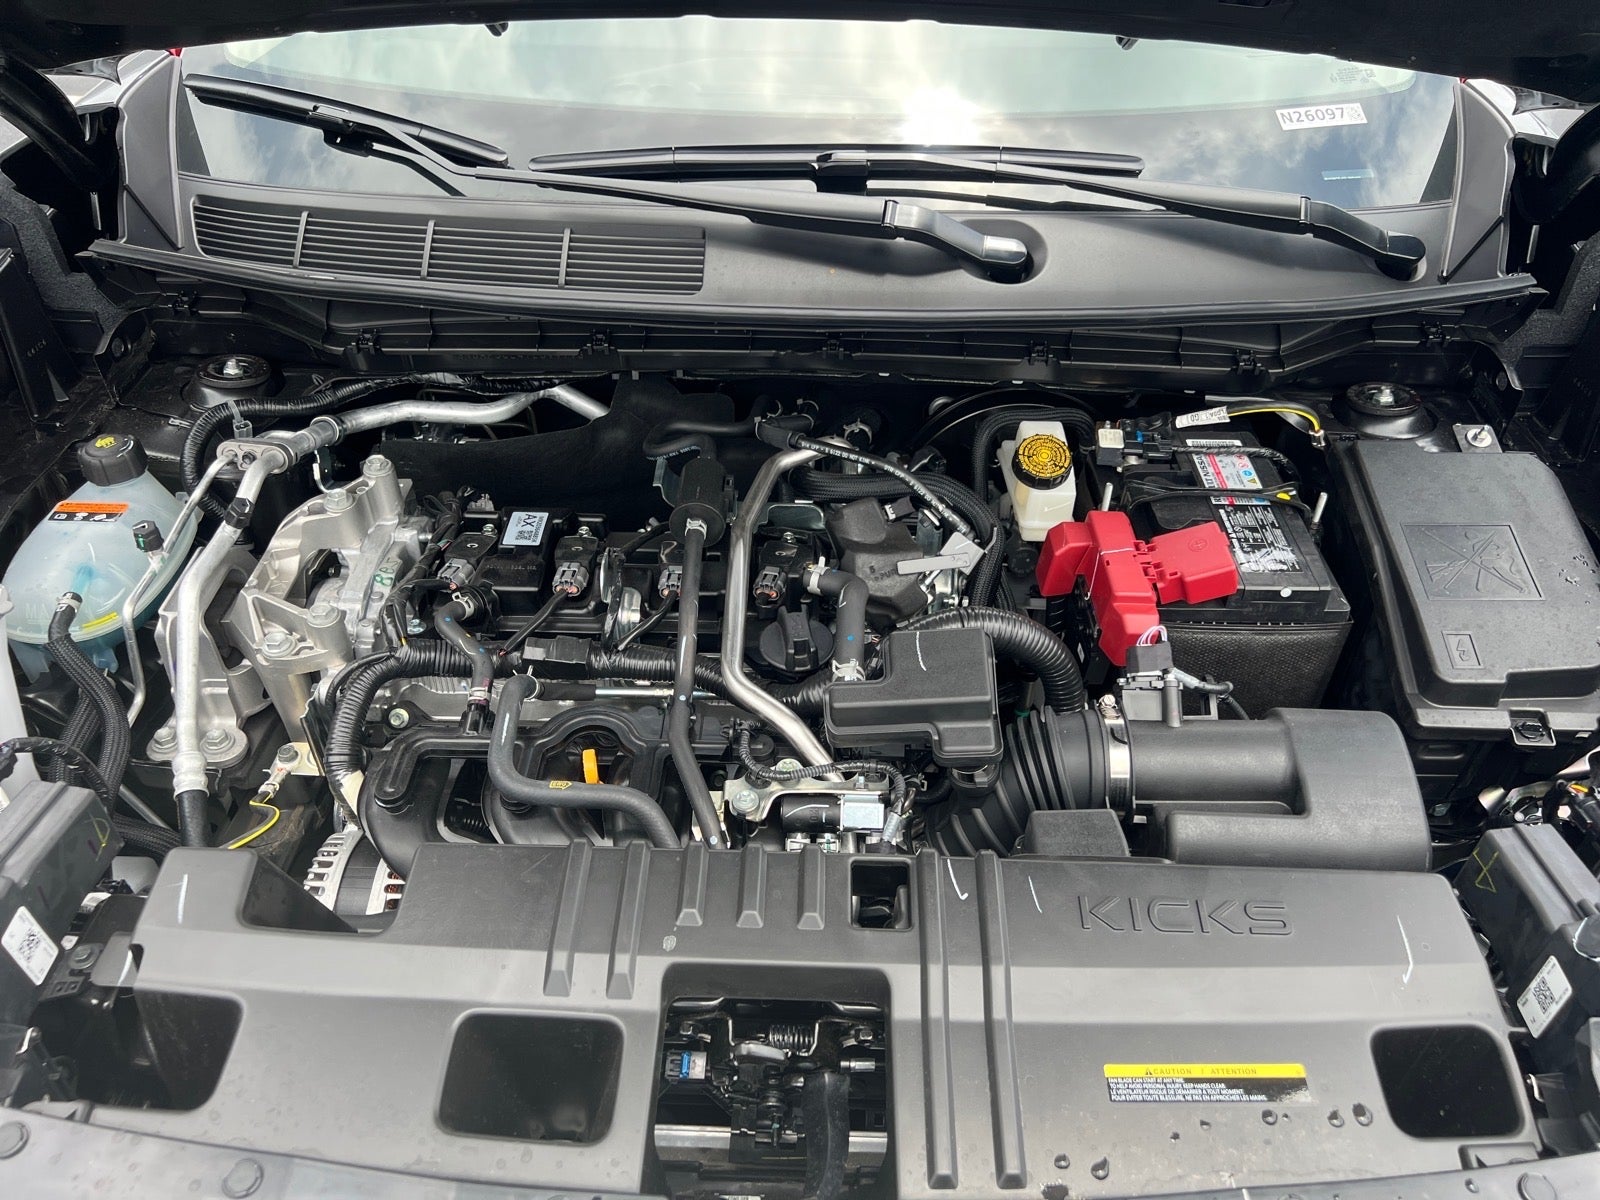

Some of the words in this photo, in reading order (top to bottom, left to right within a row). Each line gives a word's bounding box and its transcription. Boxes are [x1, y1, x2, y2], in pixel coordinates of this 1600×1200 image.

[1279, 106, 1345, 125] N26097
[521, 513, 538, 528] AX
[1078, 895, 1294, 936] KICKS
[1153, 1067, 1192, 1075] CAUTION
[1210, 1067, 1258, 1075] ATTENTION
[1111, 1094, 1126, 1102] POUR
